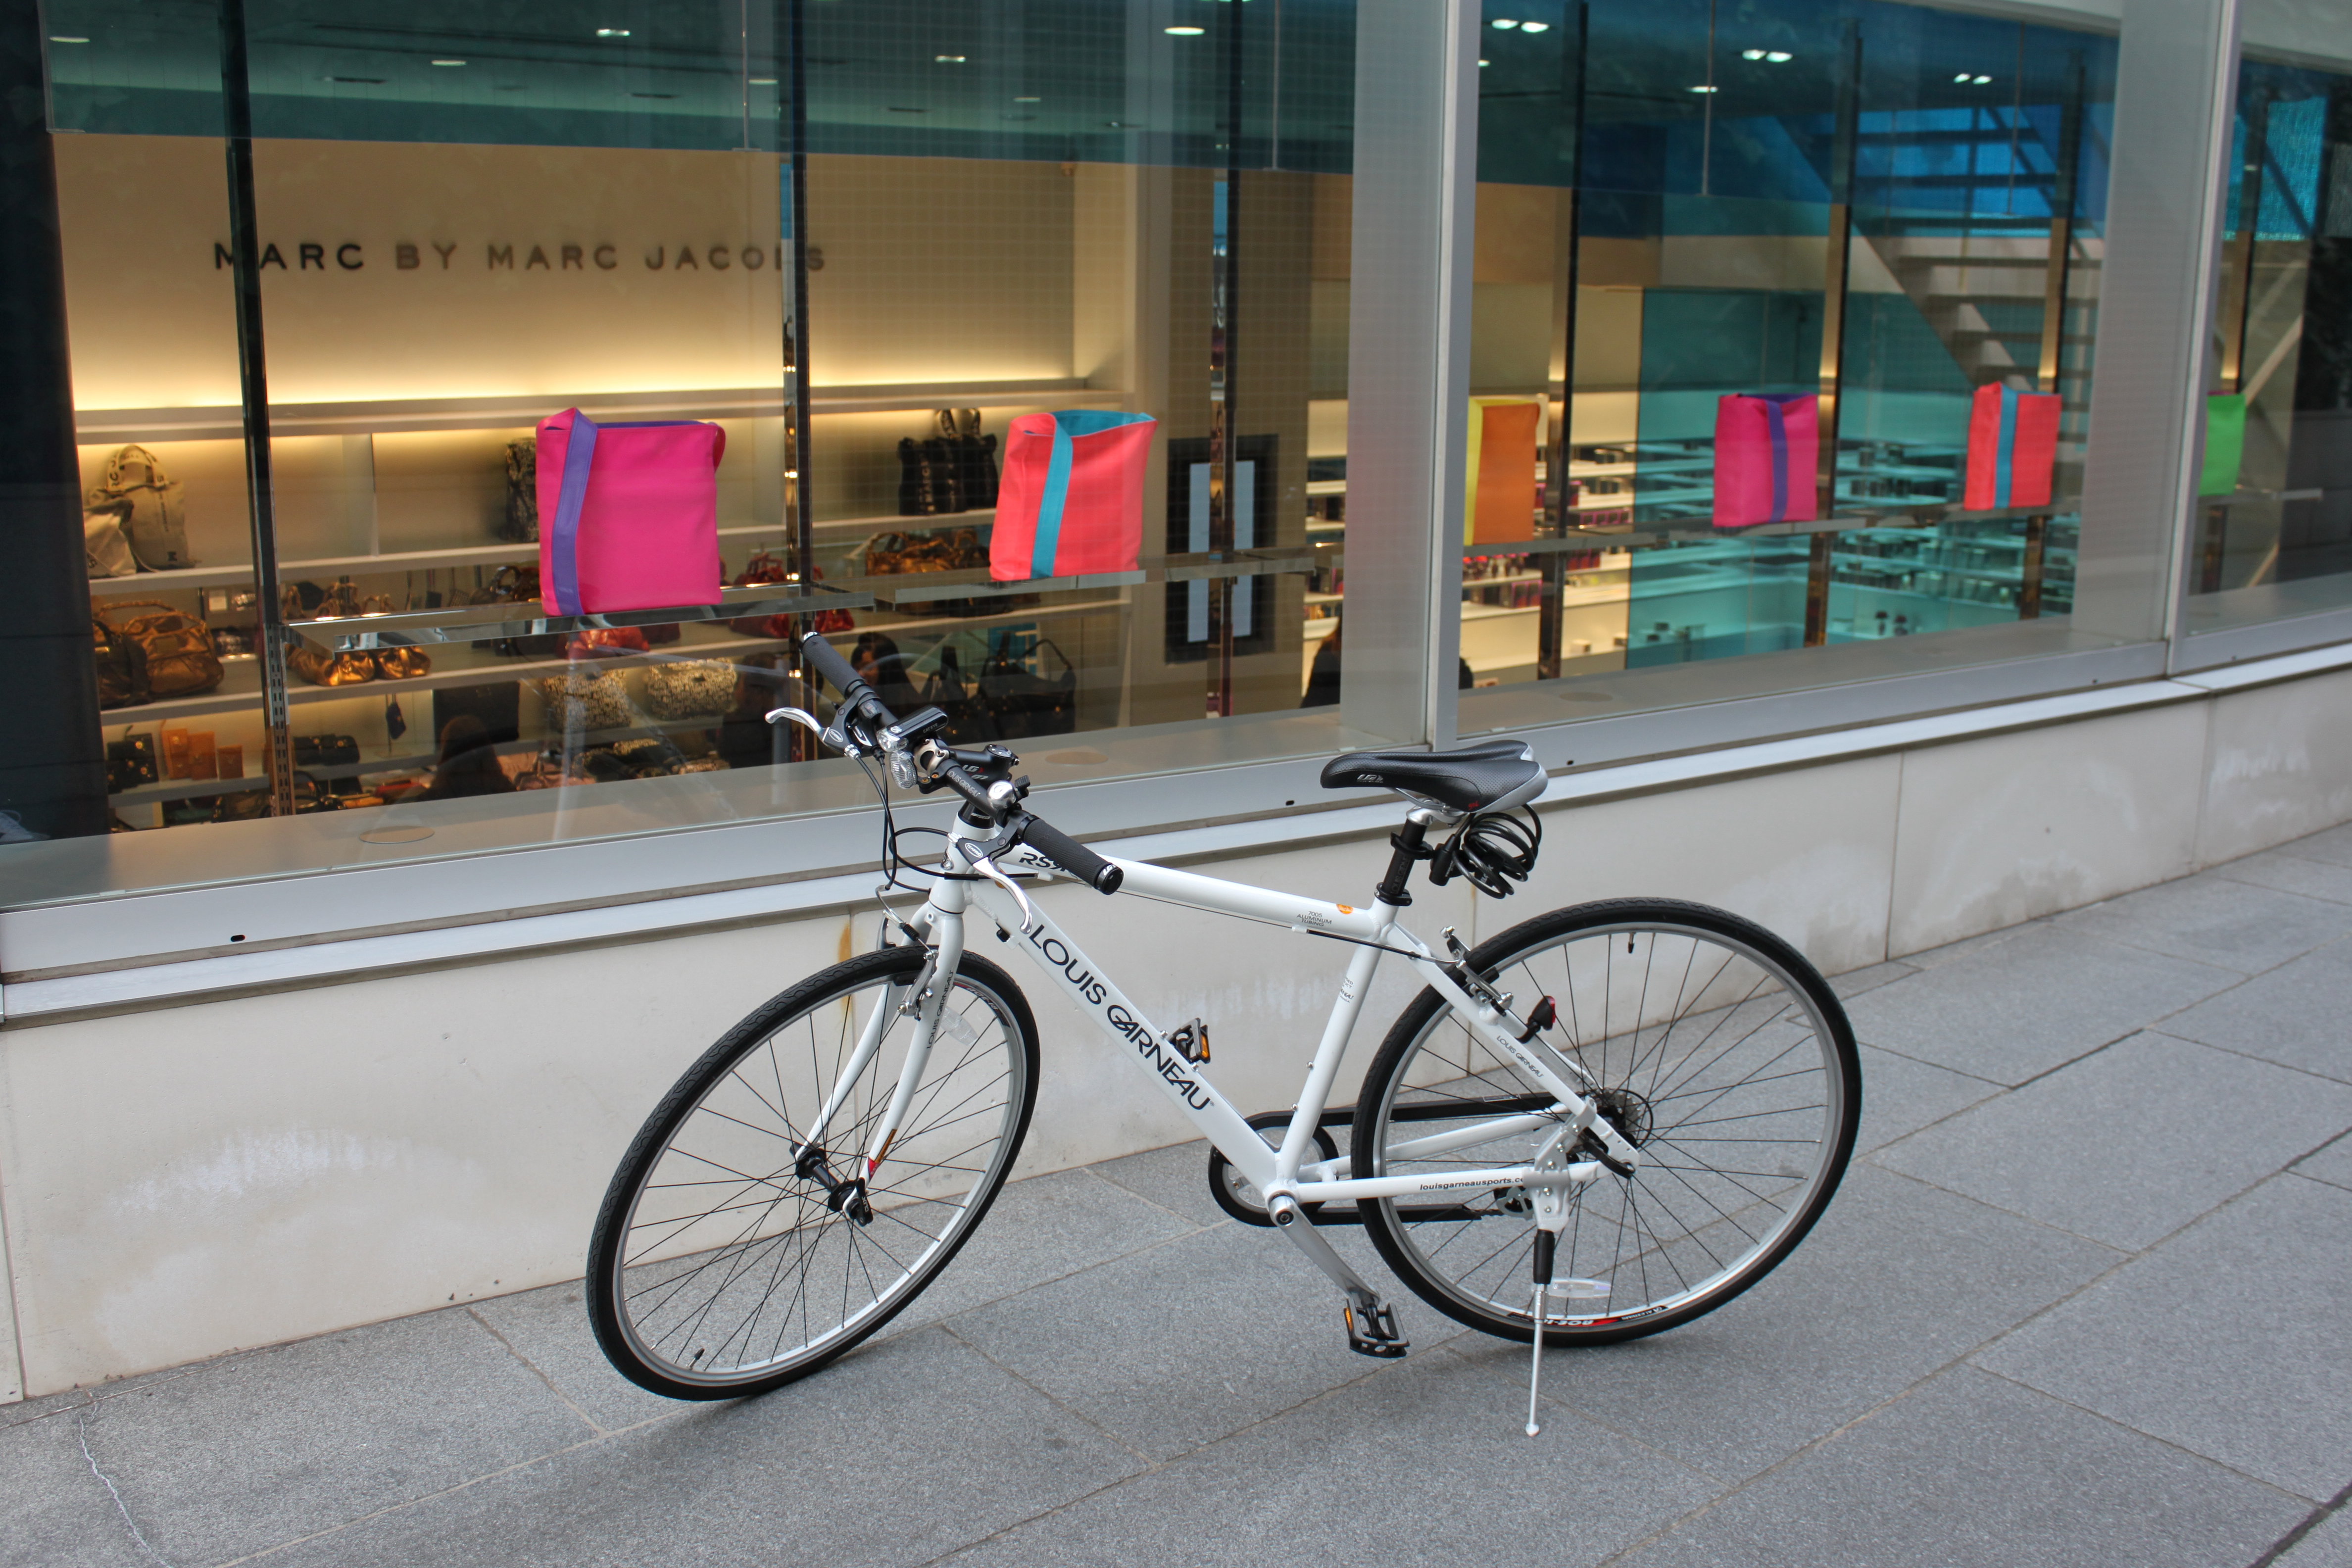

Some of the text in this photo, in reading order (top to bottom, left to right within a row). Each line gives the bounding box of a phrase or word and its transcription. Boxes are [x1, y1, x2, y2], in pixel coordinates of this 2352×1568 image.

[214, 243, 364, 270] MARC
[397, 243, 458, 270] BY
[487, 243, 618, 271] MARC
[946, 771, 979, 797] LOUIS GARNEAU
[1297, 914, 1332, 925] ALUMINUM
[1301, 919, 1324, 927] TUBING
[927, 970, 954, 1049] LOUIS GARNEAU
[1029, 924, 1211, 1110] LOUIS GARNEAU
[1496, 1035, 1543, 1078] LOUIS GARNEAU
